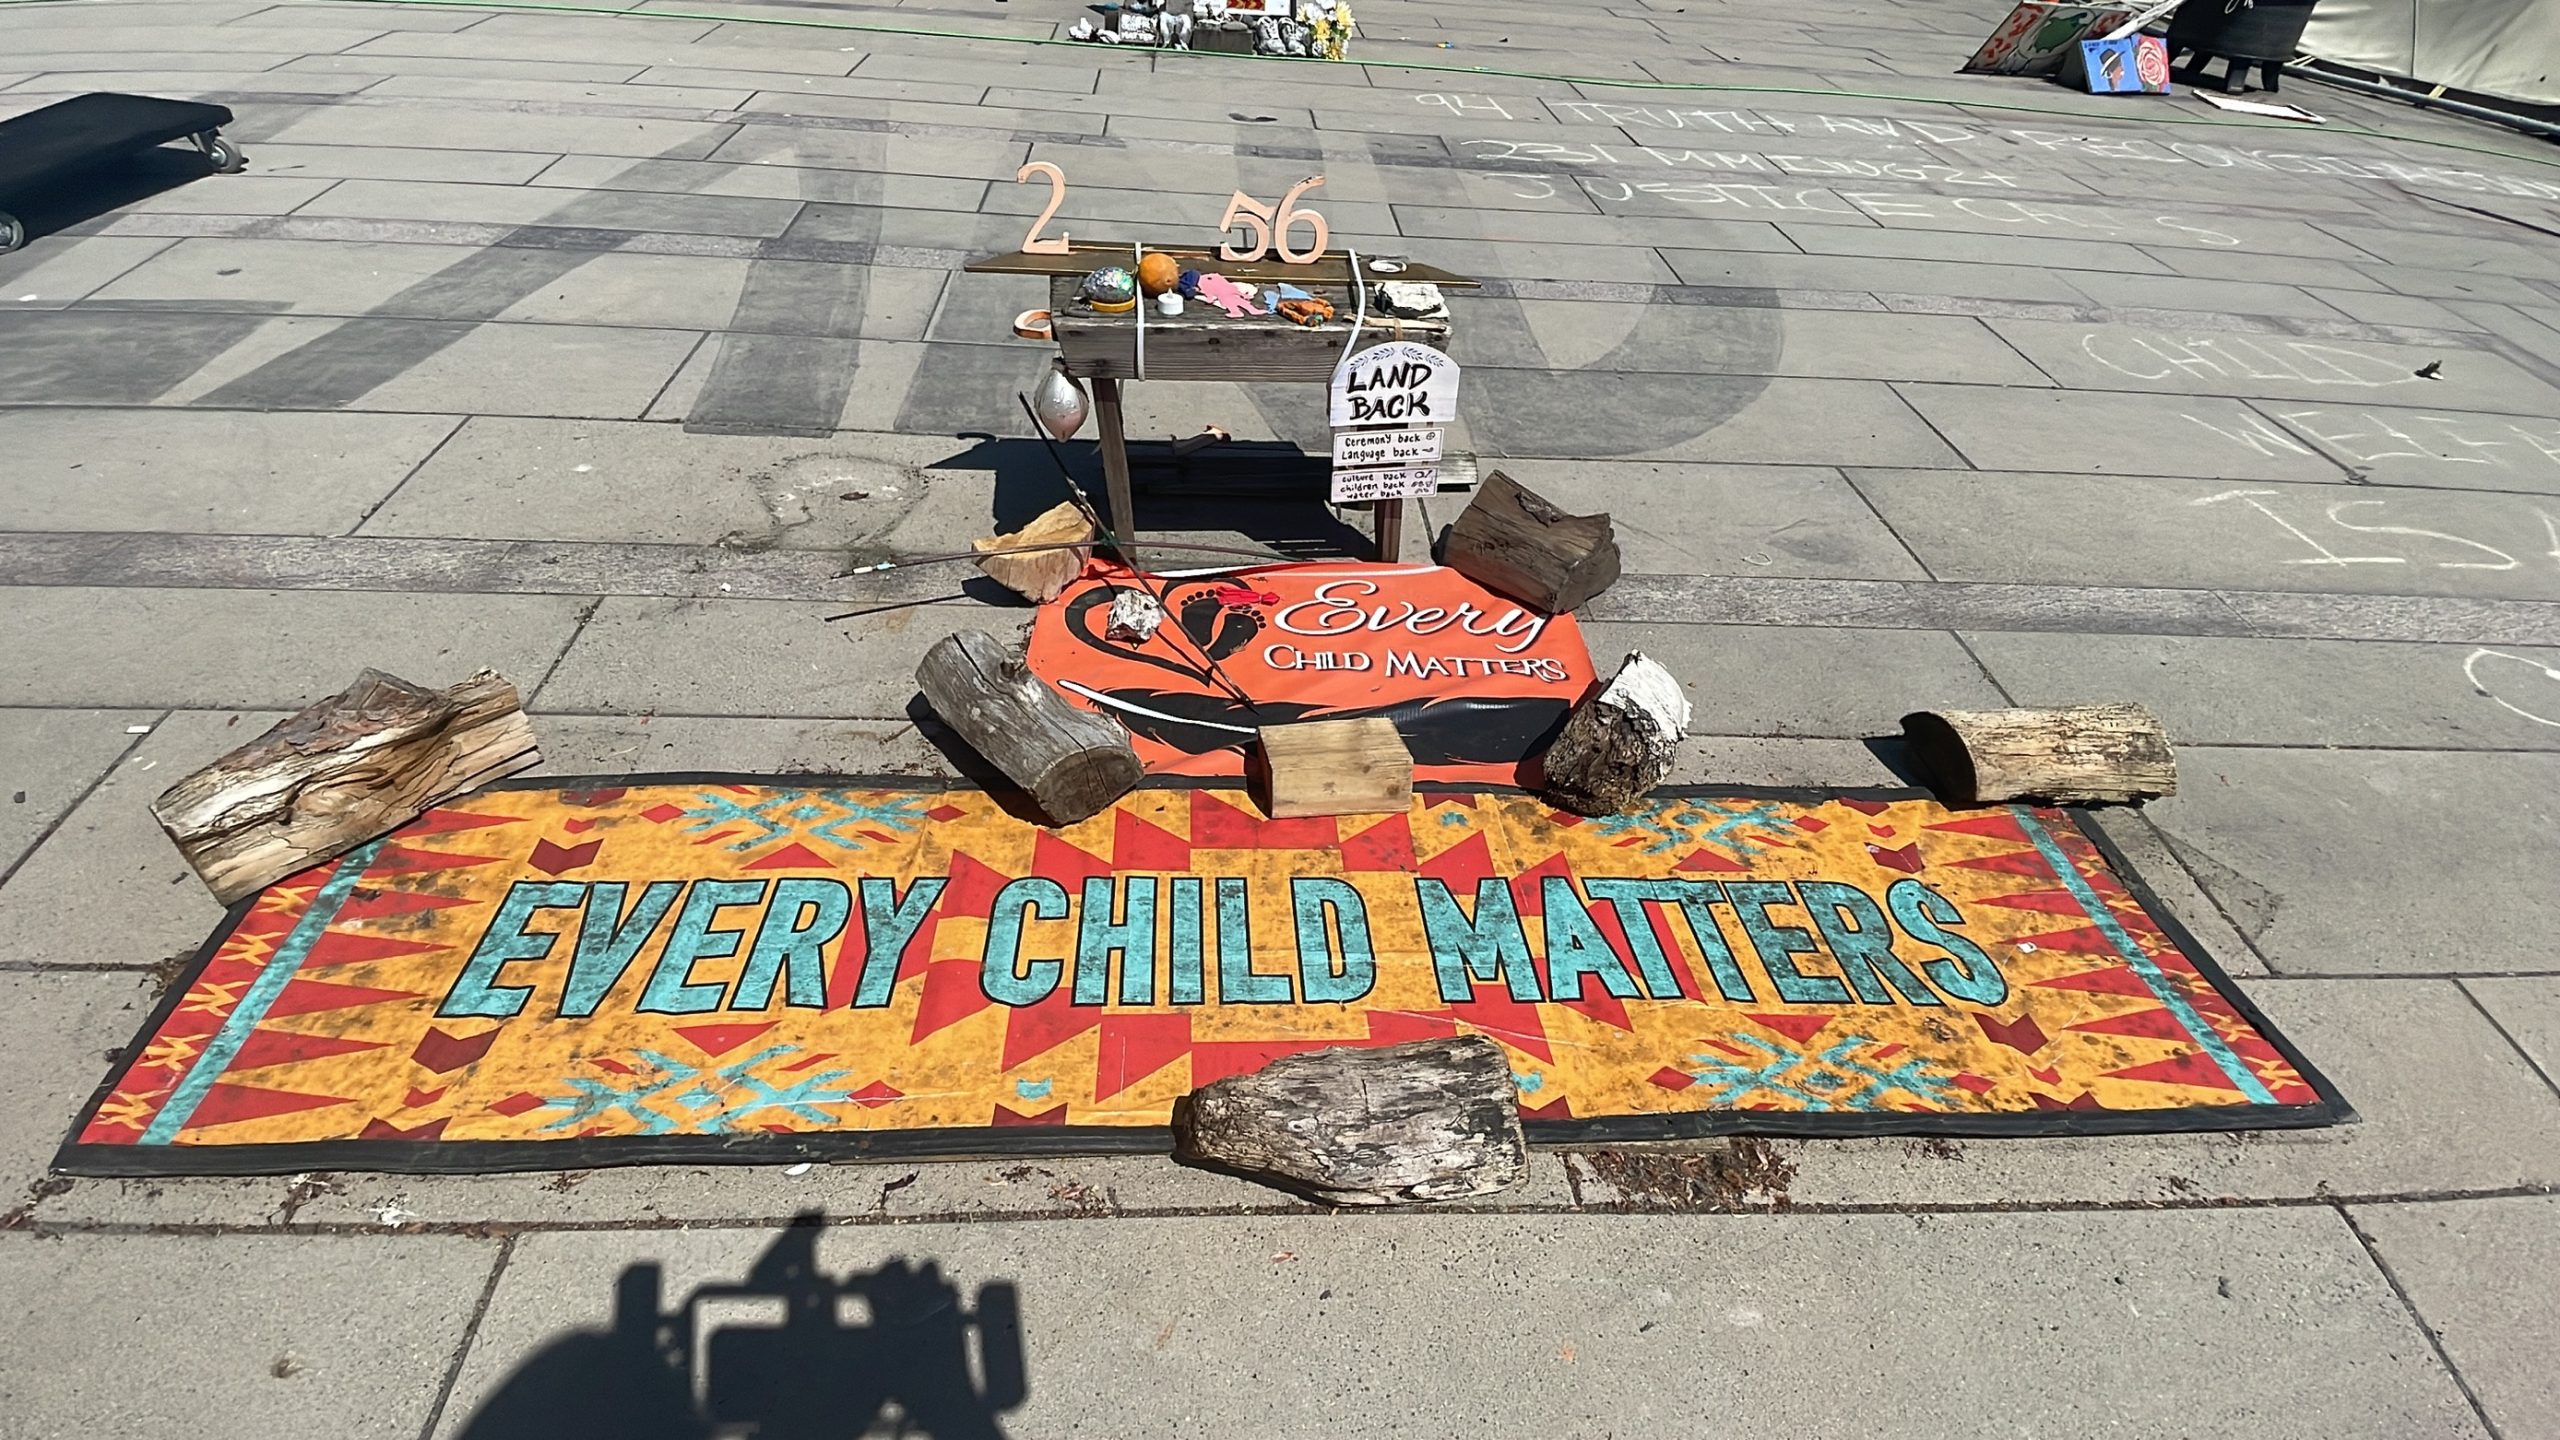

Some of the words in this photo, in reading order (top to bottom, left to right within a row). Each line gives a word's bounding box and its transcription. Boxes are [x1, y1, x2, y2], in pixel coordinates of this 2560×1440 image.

[1415, 92, 1513, 121] 94
[1560, 101, 1797, 136] TRUTH
[1815, 113, 1975, 144] AND
[1460, 139, 1618, 165] 231
[1016, 160, 1070, 255] 2
[1218, 175, 1329, 265] 56
[1485, 172, 1934, 219] JUSTICE
[1347, 362, 1432, 394] LAND
[2082, 334, 2420, 388] CHILD
[1347, 391, 1431, 421] BACK
[1393, 446, 1419, 456] back
[1397, 433, 1421, 443] back
[1274, 578, 1546, 653] Every
[1263, 643, 1372, 673] CHILD
[1384, 648, 1569, 683] MATTERS
[435, 875, 953, 1019] EVERY
[979, 875, 1377, 1007] CHILD
[1414, 875, 2009, 1007] MATTERS
